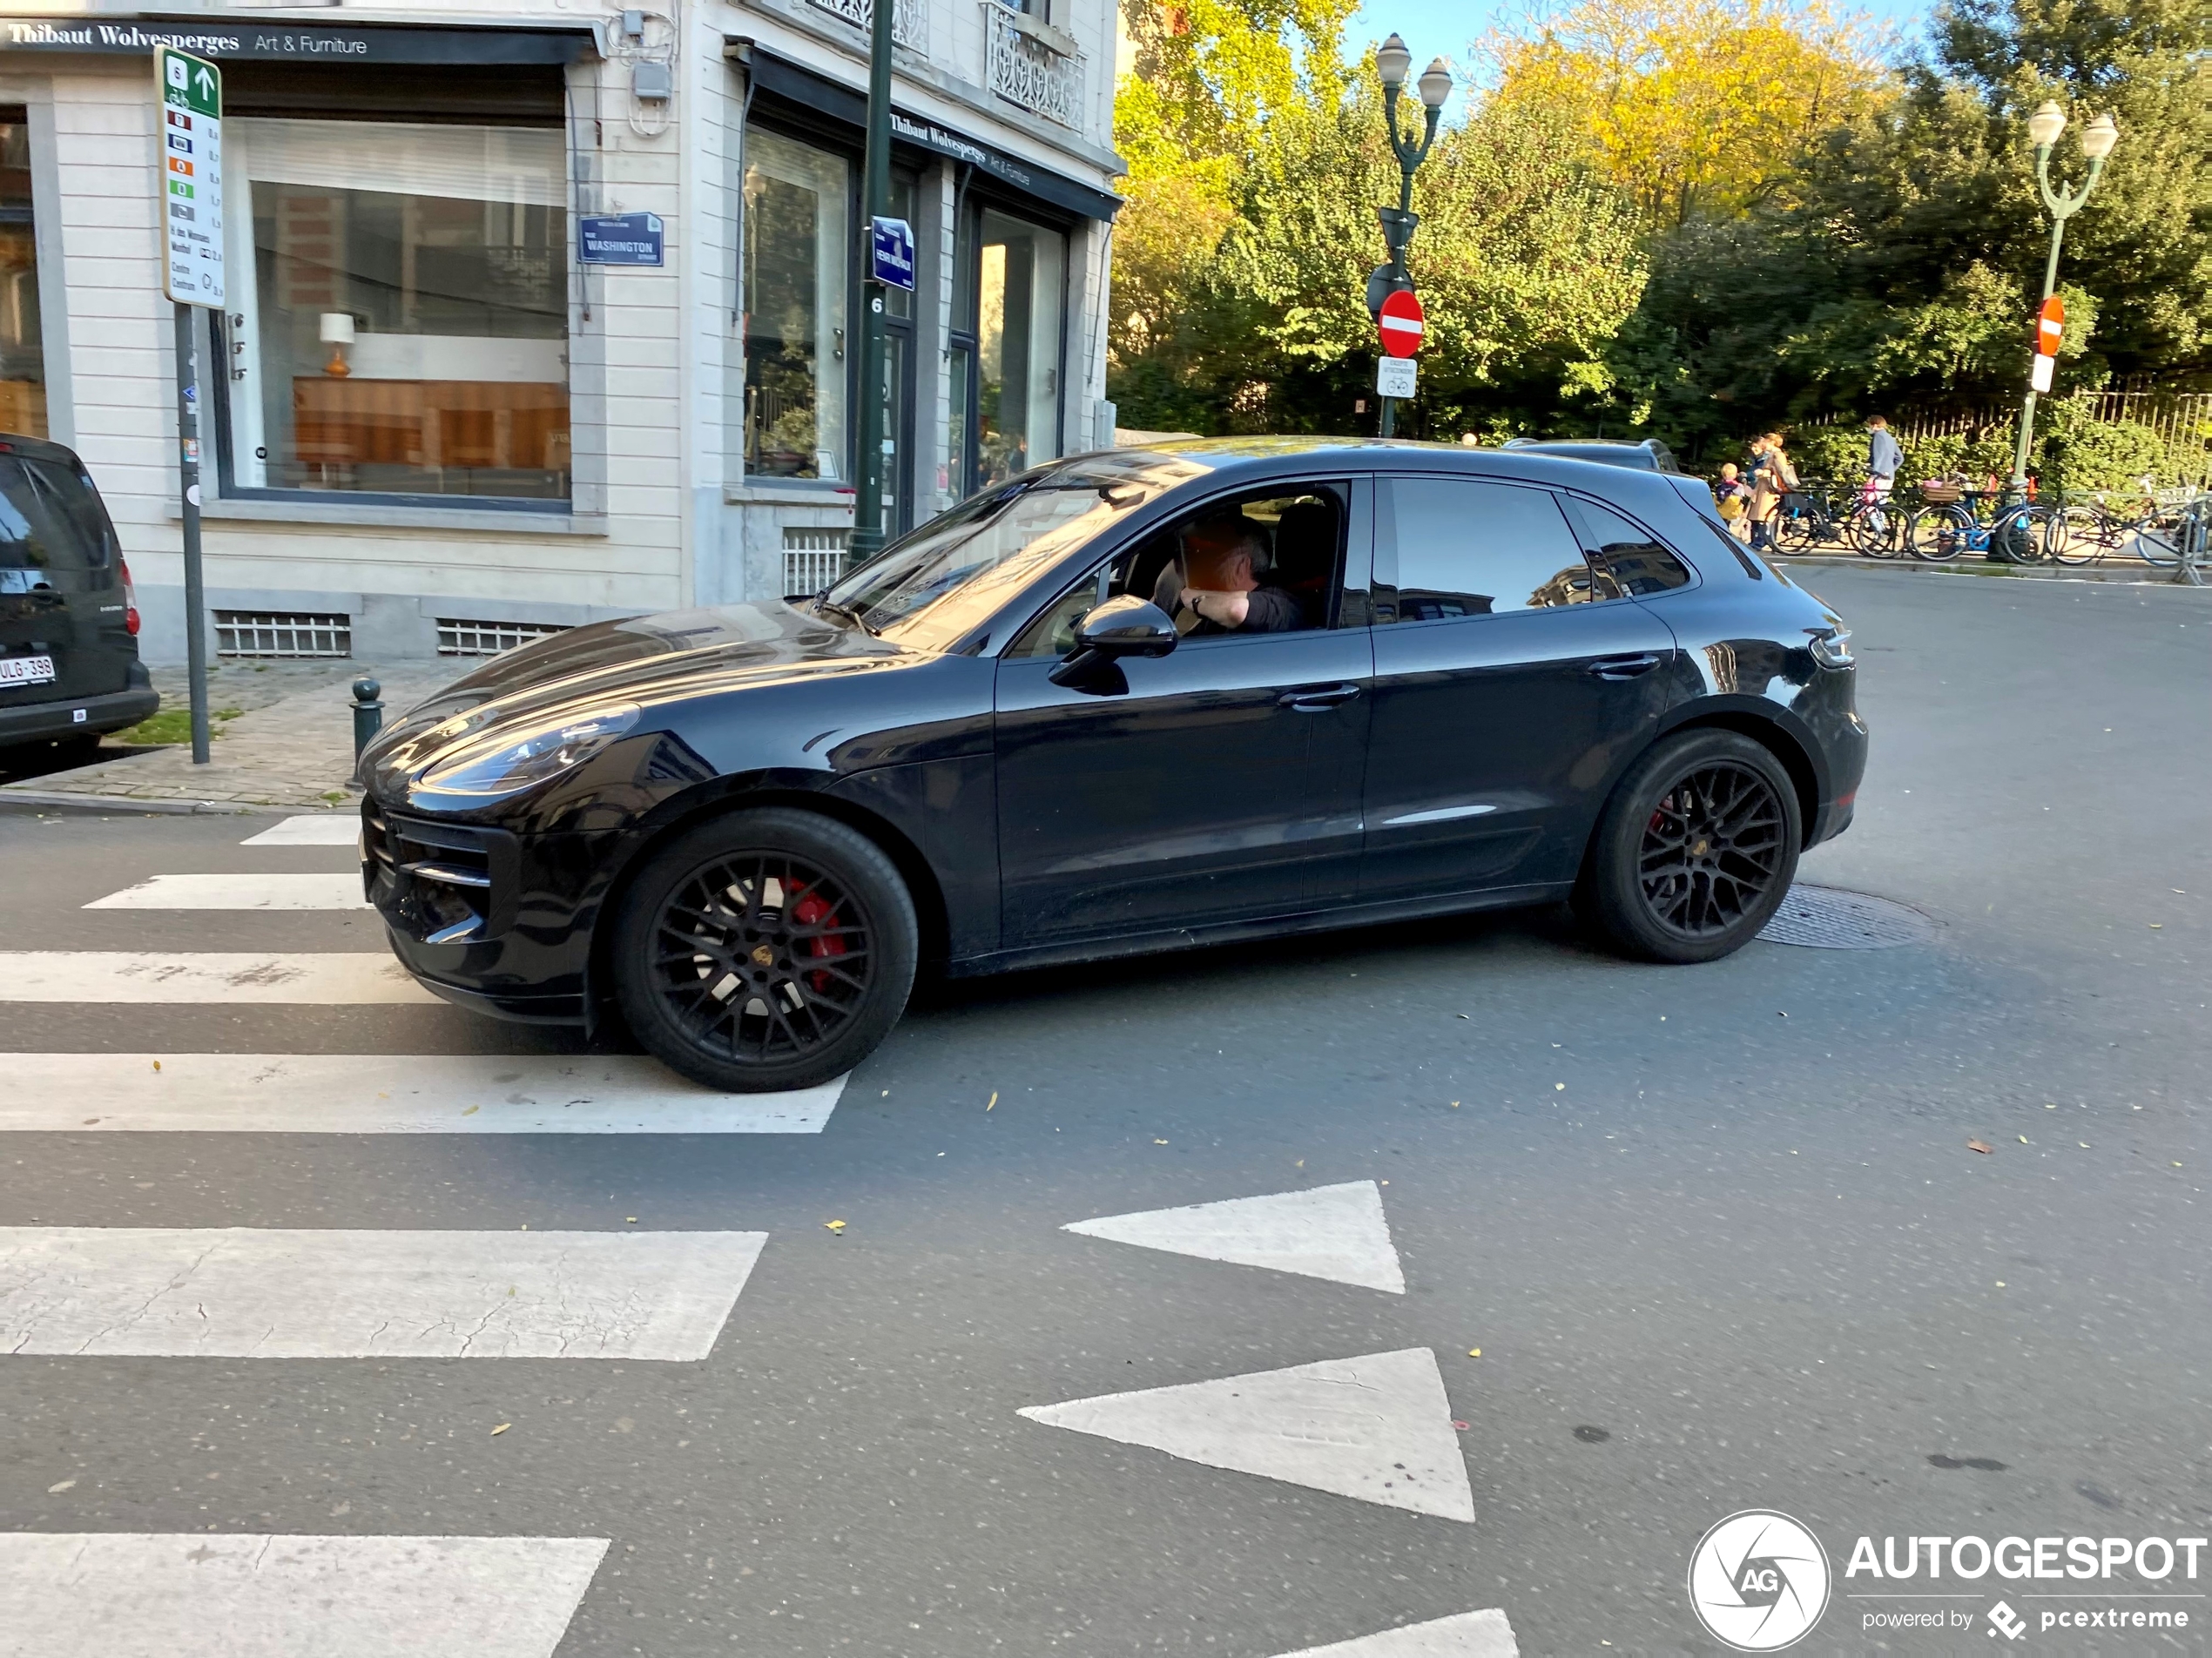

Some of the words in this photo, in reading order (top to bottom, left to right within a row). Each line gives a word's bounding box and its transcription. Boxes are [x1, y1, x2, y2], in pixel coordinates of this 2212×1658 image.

[7, 23, 93, 44] Thibaut
[97, 24, 240, 55] Wolvesperges
[254, 34, 280, 51] Art
[283, 35, 297, 52] &
[300, 36, 368, 54] Furniture
[586, 239, 653, 253] WASHINGTON
[871, 297, 883, 313] 6
